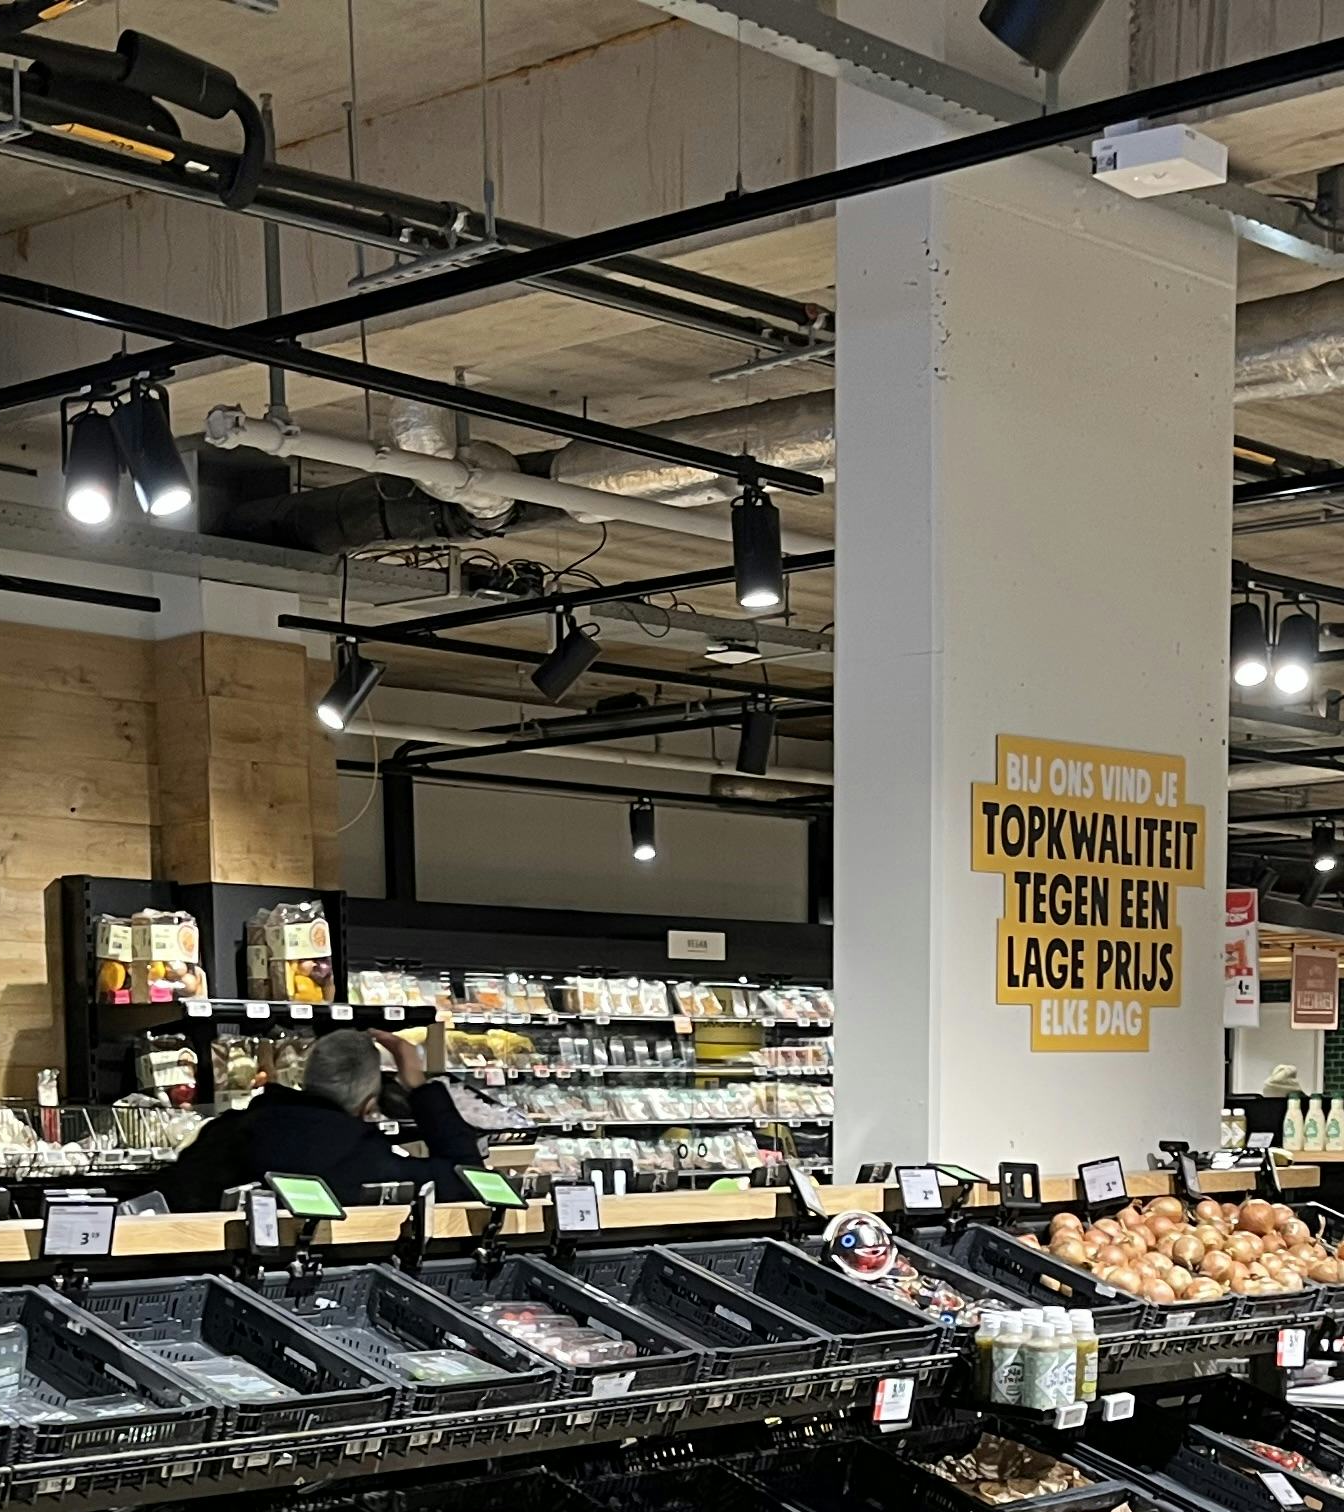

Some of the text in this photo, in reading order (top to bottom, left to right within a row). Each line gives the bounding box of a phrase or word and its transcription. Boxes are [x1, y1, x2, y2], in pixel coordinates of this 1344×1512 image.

[1006, 752, 1178, 808] BIJ ONS VIND JE
[982, 801, 1198, 871] TOPKWALITEIT
[1014, 871, 1170, 930] TEGEN EEN
[1007, 935, 1174, 992] LAGE PRIJS
[1040, 1000, 1142, 1037] ELKE DAG
